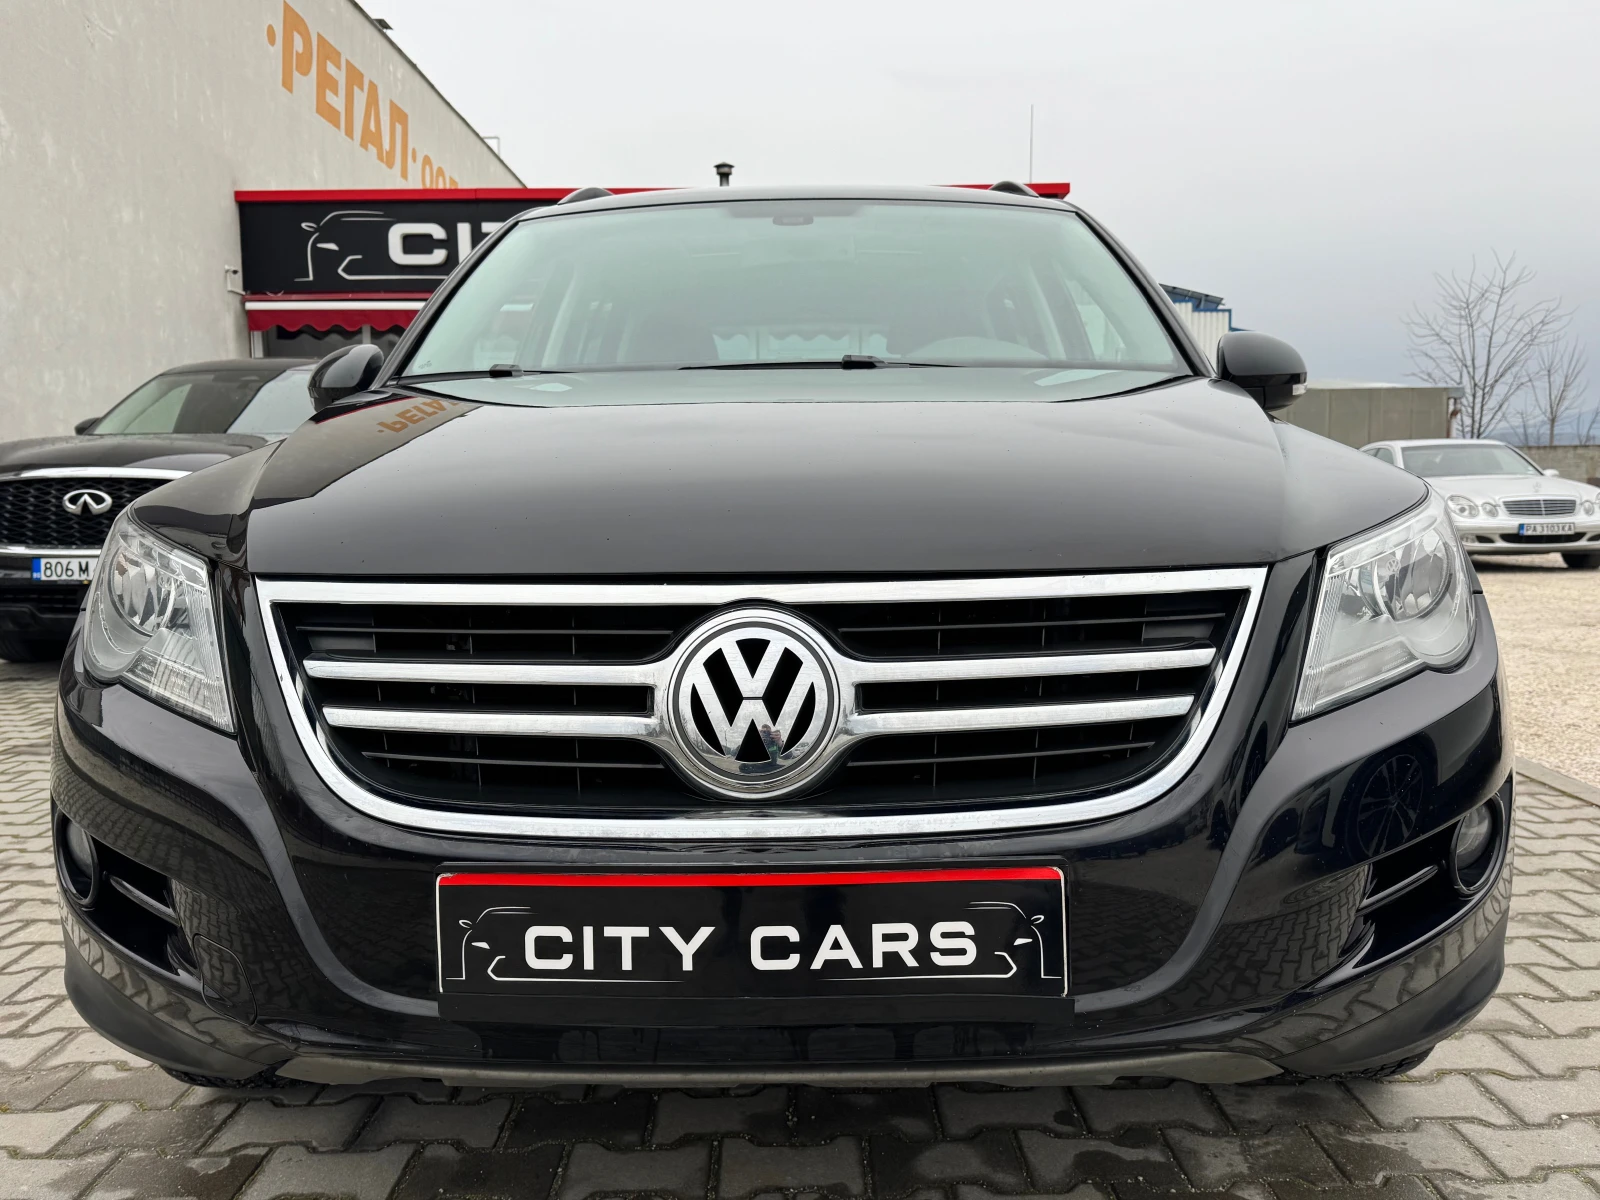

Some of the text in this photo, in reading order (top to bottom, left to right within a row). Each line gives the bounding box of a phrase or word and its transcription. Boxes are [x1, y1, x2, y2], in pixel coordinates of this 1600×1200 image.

[281, 0, 409, 182] РЕГАЛ
[43, 561, 74, 578] 806
[684, 630, 823, 770] VW
[524, 920, 977, 971] CITY CARS
